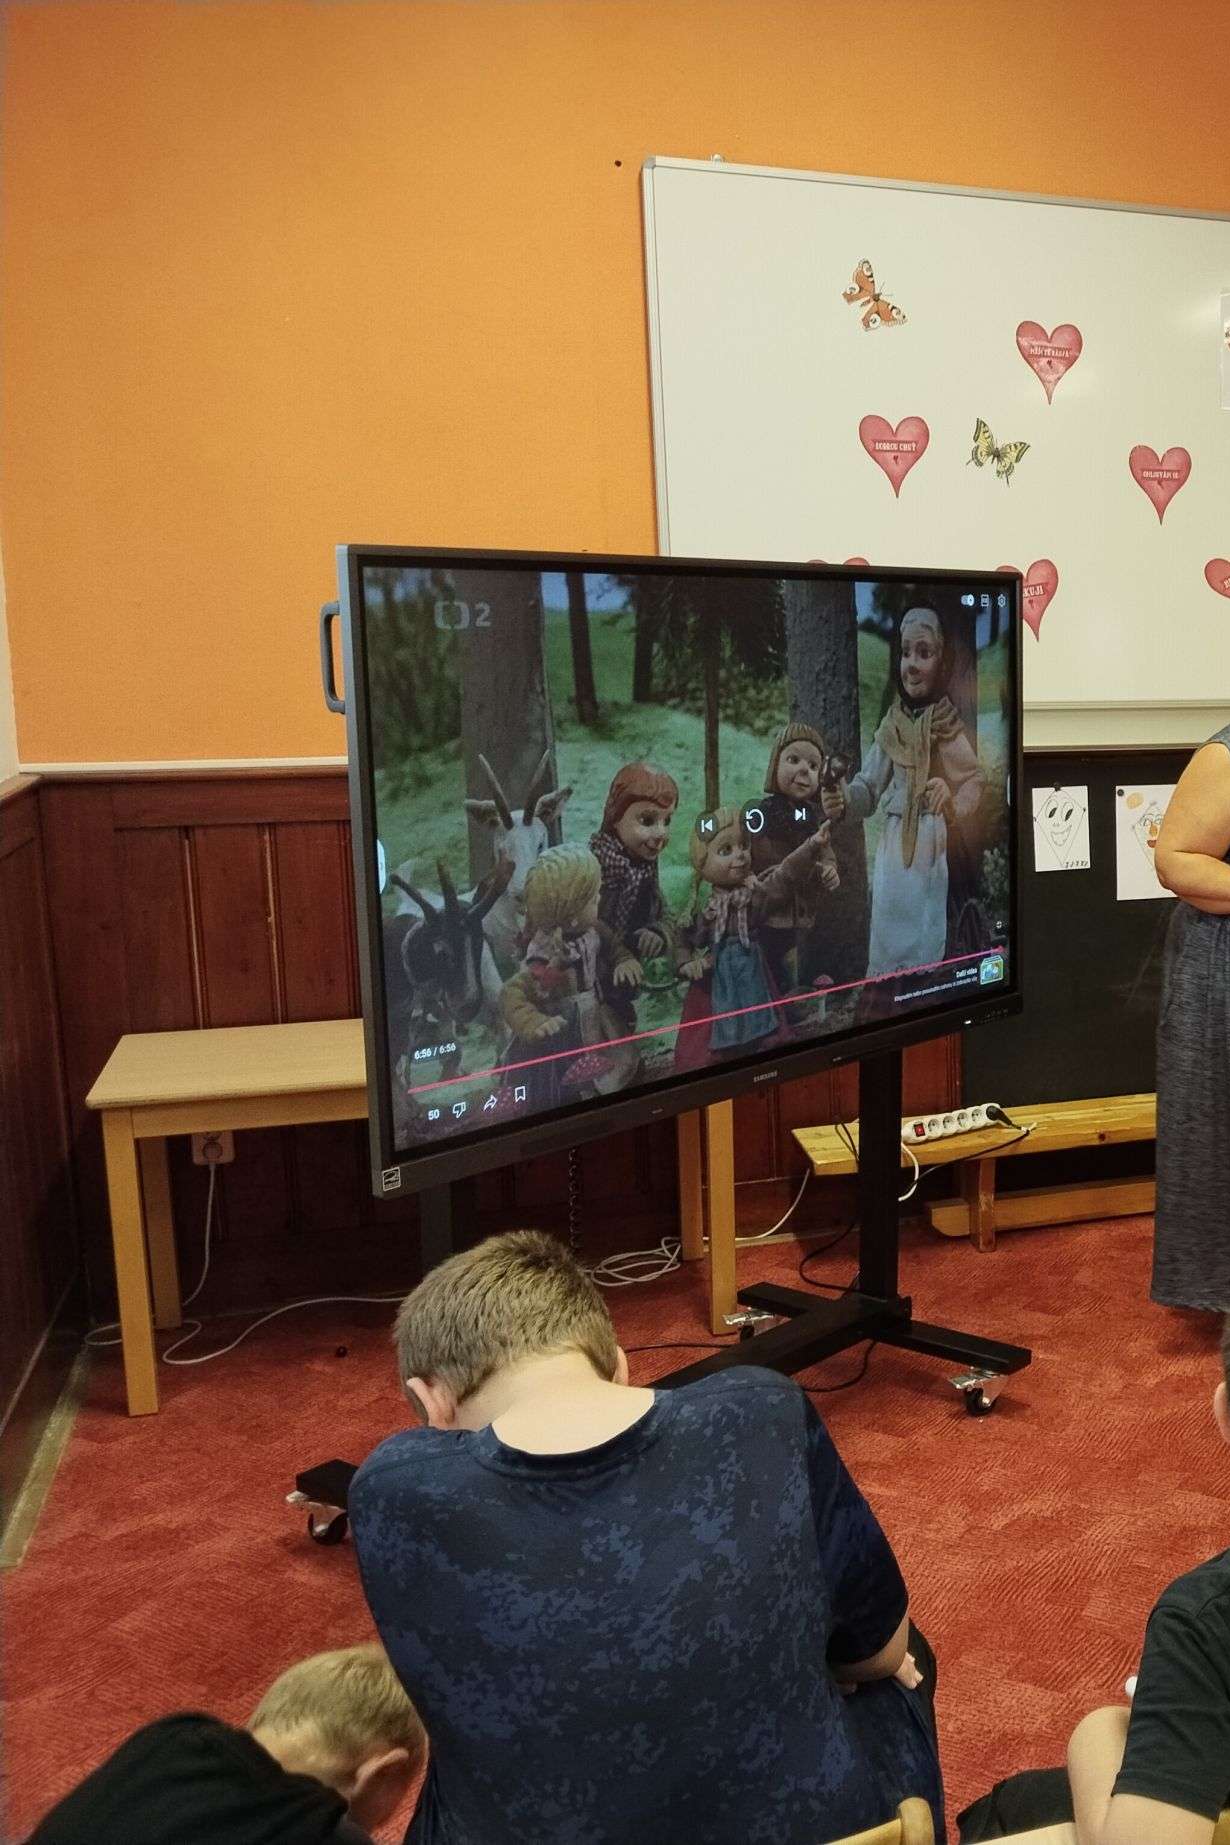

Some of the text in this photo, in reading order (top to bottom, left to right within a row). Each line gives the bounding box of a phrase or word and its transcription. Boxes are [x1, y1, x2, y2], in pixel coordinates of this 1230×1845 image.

[1023, 584, 1045, 597] KUJI
[414, 1047, 432, 1060] 6:56
[439, 1042, 456, 1054] 6:56
[428, 1108, 440, 1121] 50
